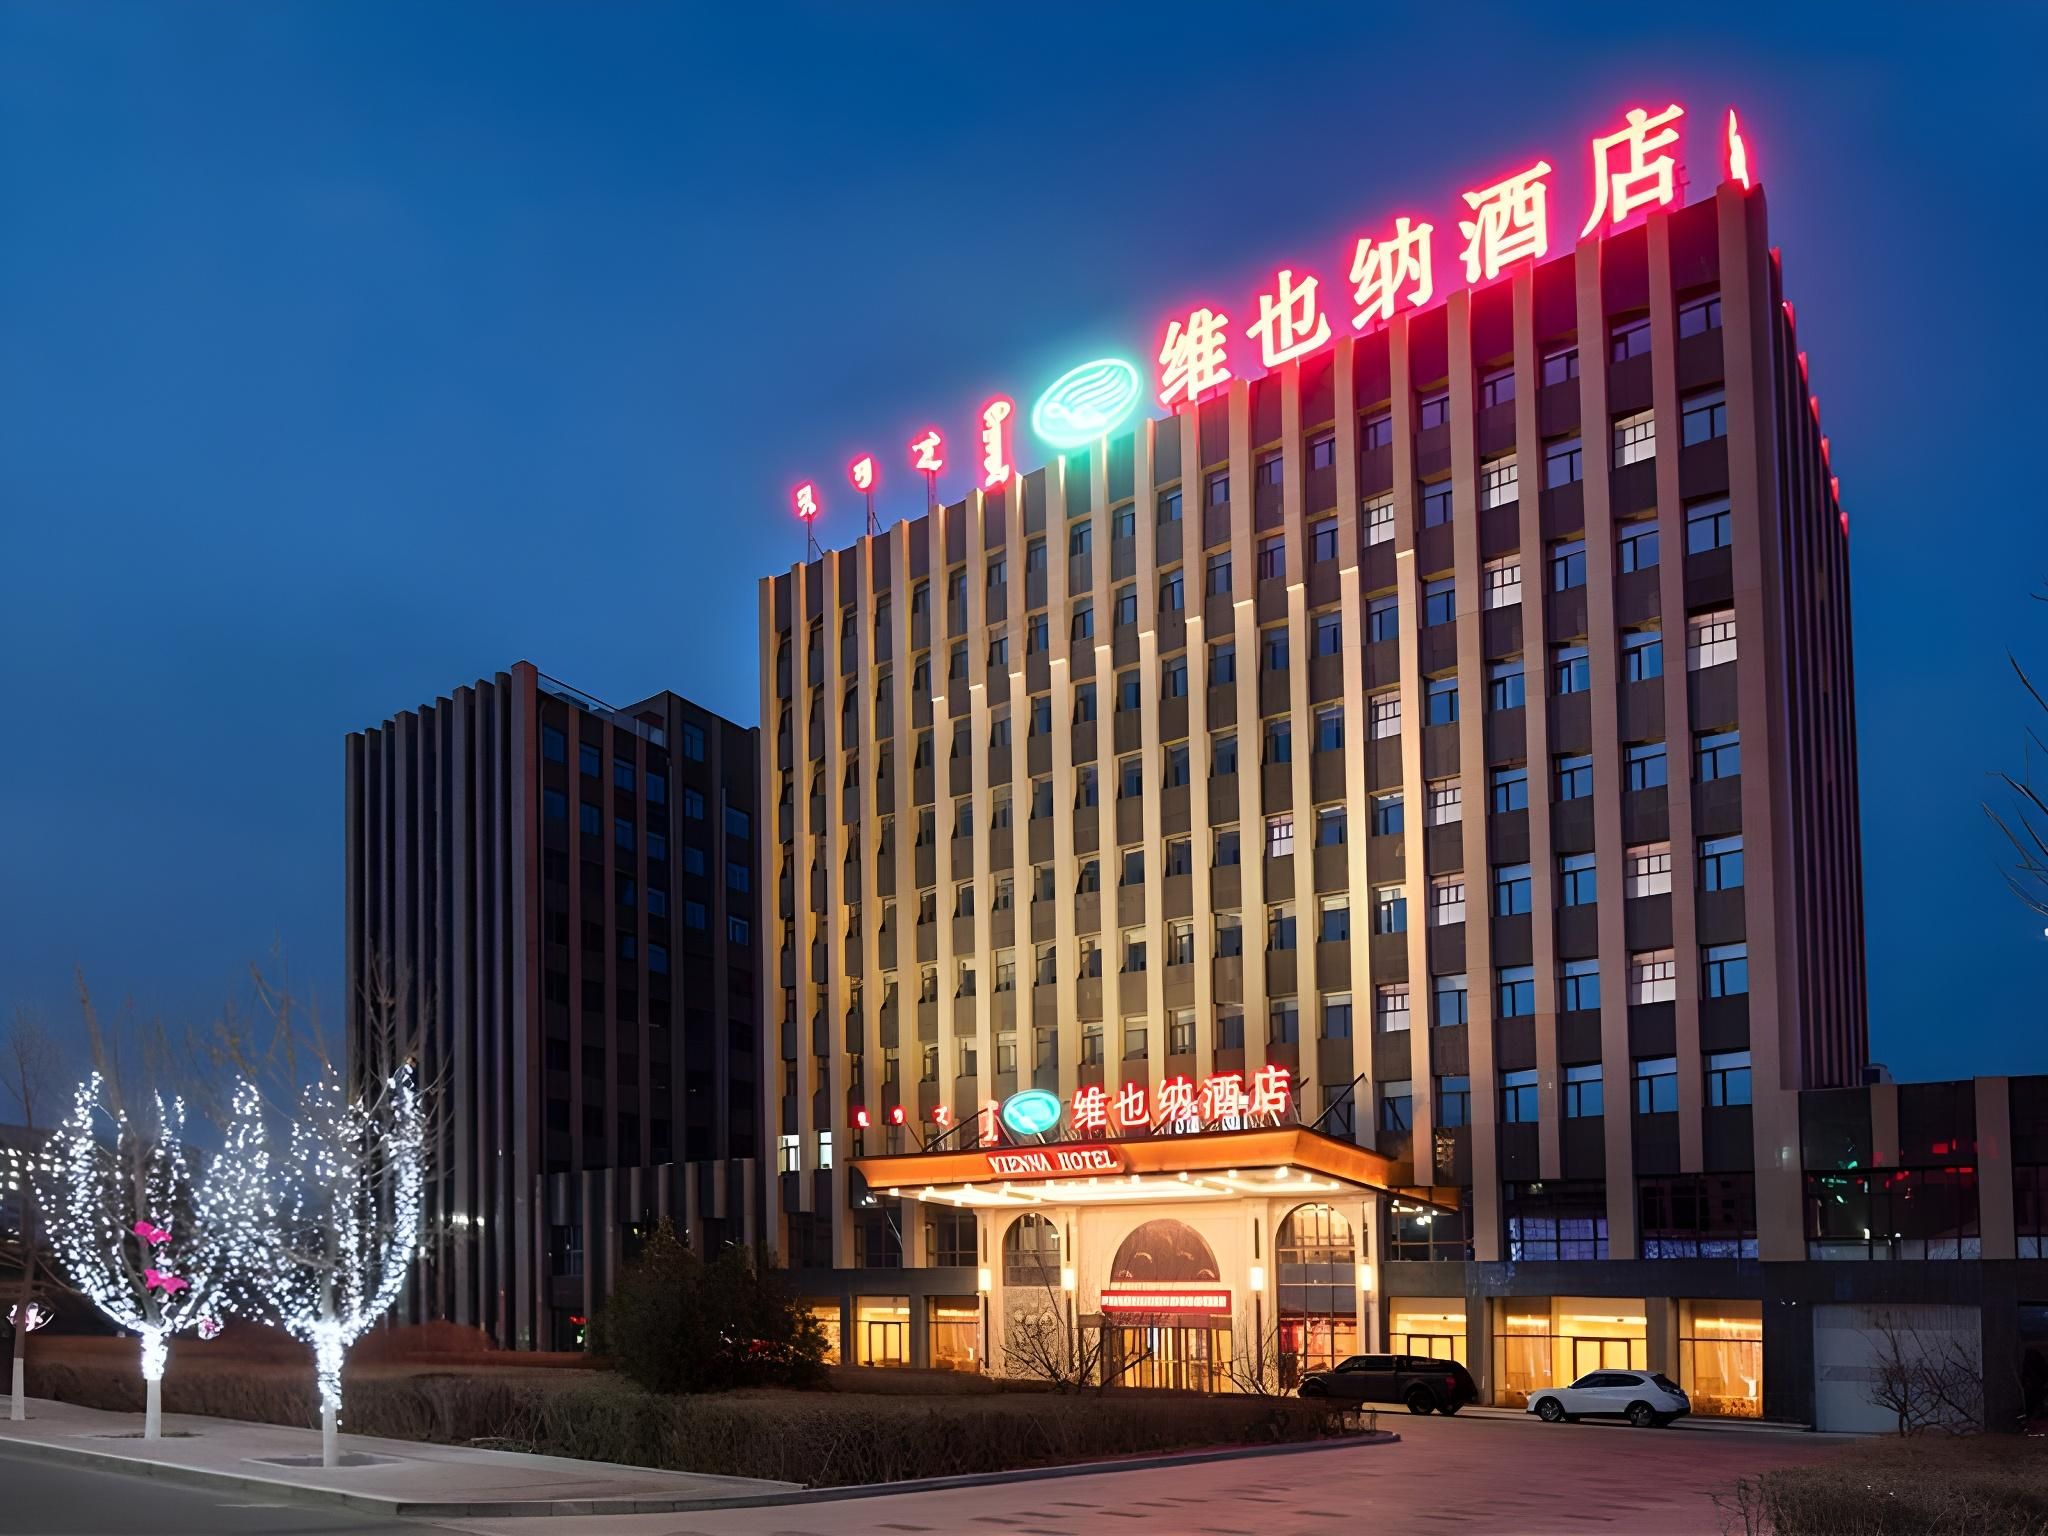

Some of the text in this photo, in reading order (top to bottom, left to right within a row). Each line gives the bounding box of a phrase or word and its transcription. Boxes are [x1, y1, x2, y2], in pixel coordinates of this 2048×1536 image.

[1159, 104, 1685, 406] 维也纳酒店
[1073, 1065, 1290, 1129] 维也纳酒店
[1057, 1149, 1118, 1171] HOTEL
